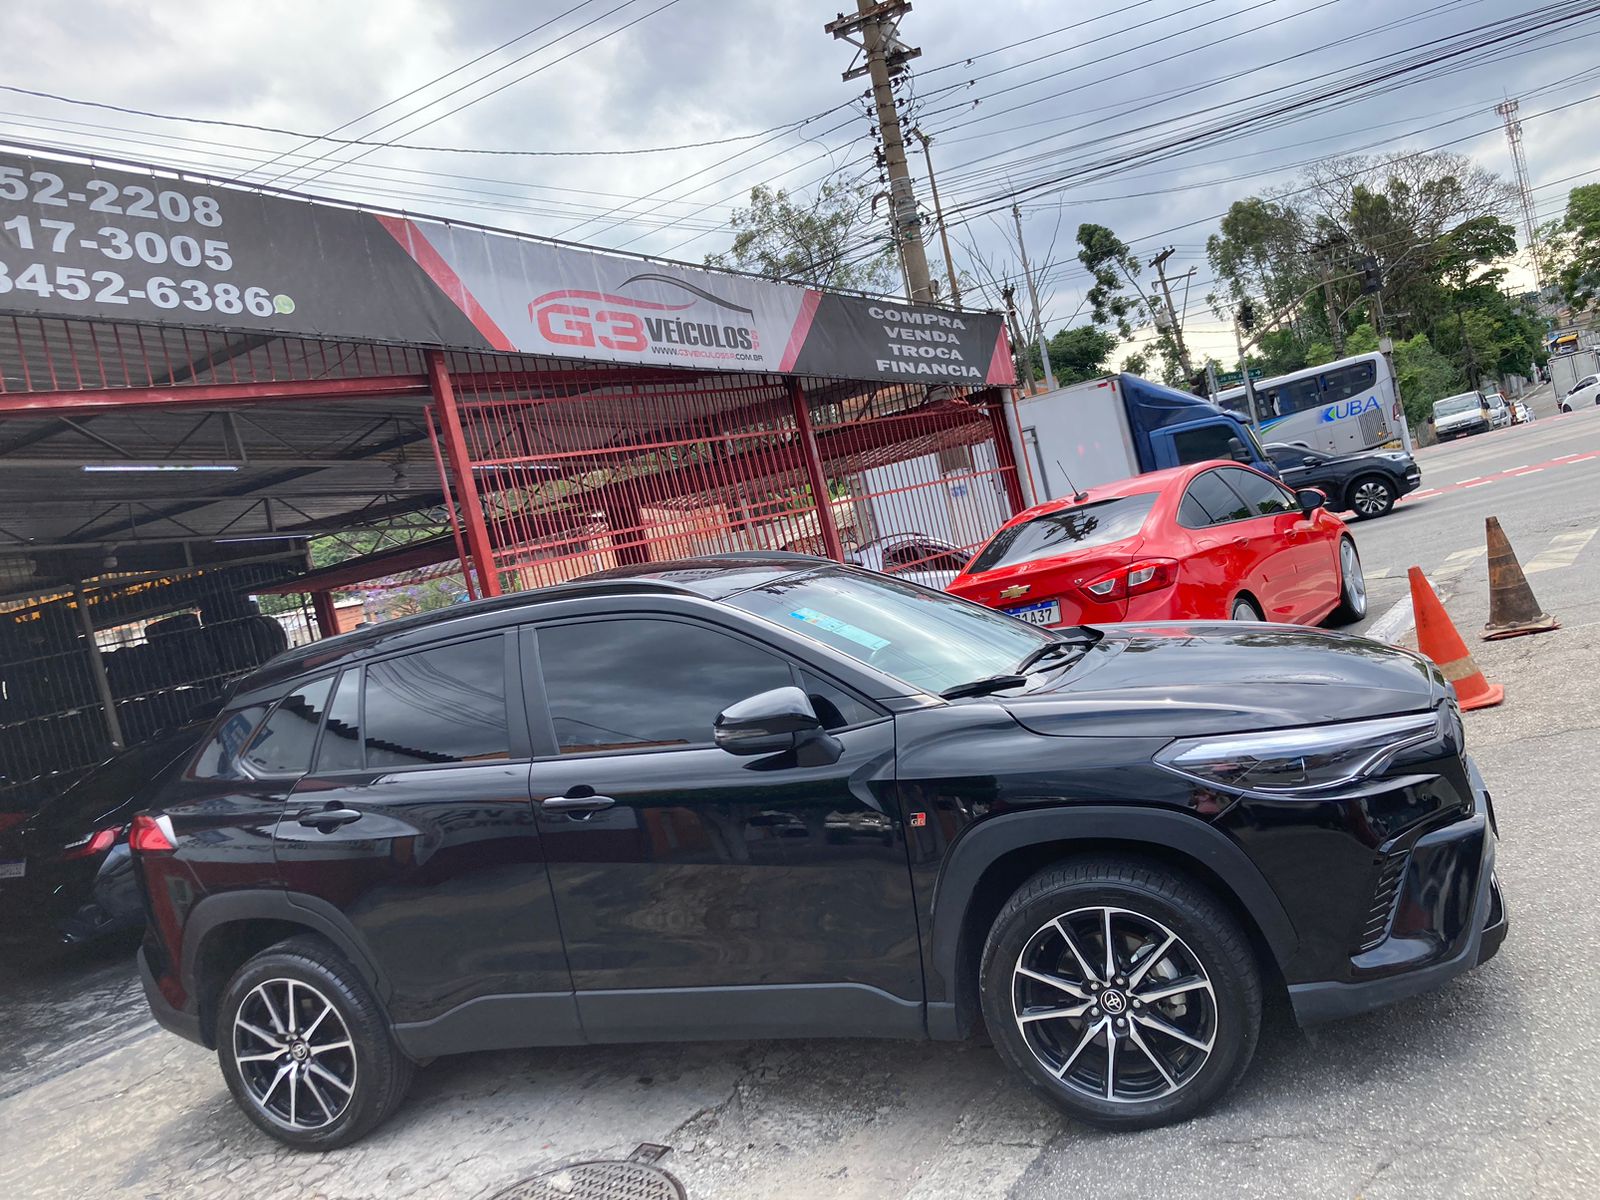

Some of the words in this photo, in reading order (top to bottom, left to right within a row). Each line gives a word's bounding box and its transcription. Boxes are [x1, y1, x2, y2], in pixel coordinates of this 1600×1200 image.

[0, 166, 223, 227] 52-2208
[4, 215, 233, 271] 17-3005
[537, 303, 648, 352] G3
[644, 317, 753, 350] VEÍCULOS
[868, 306, 966, 330] COMPRA
[883, 325, 960, 345] VENDA
[888, 343, 963, 360] TROCA
[876, 359, 982, 377] FINANCIA
